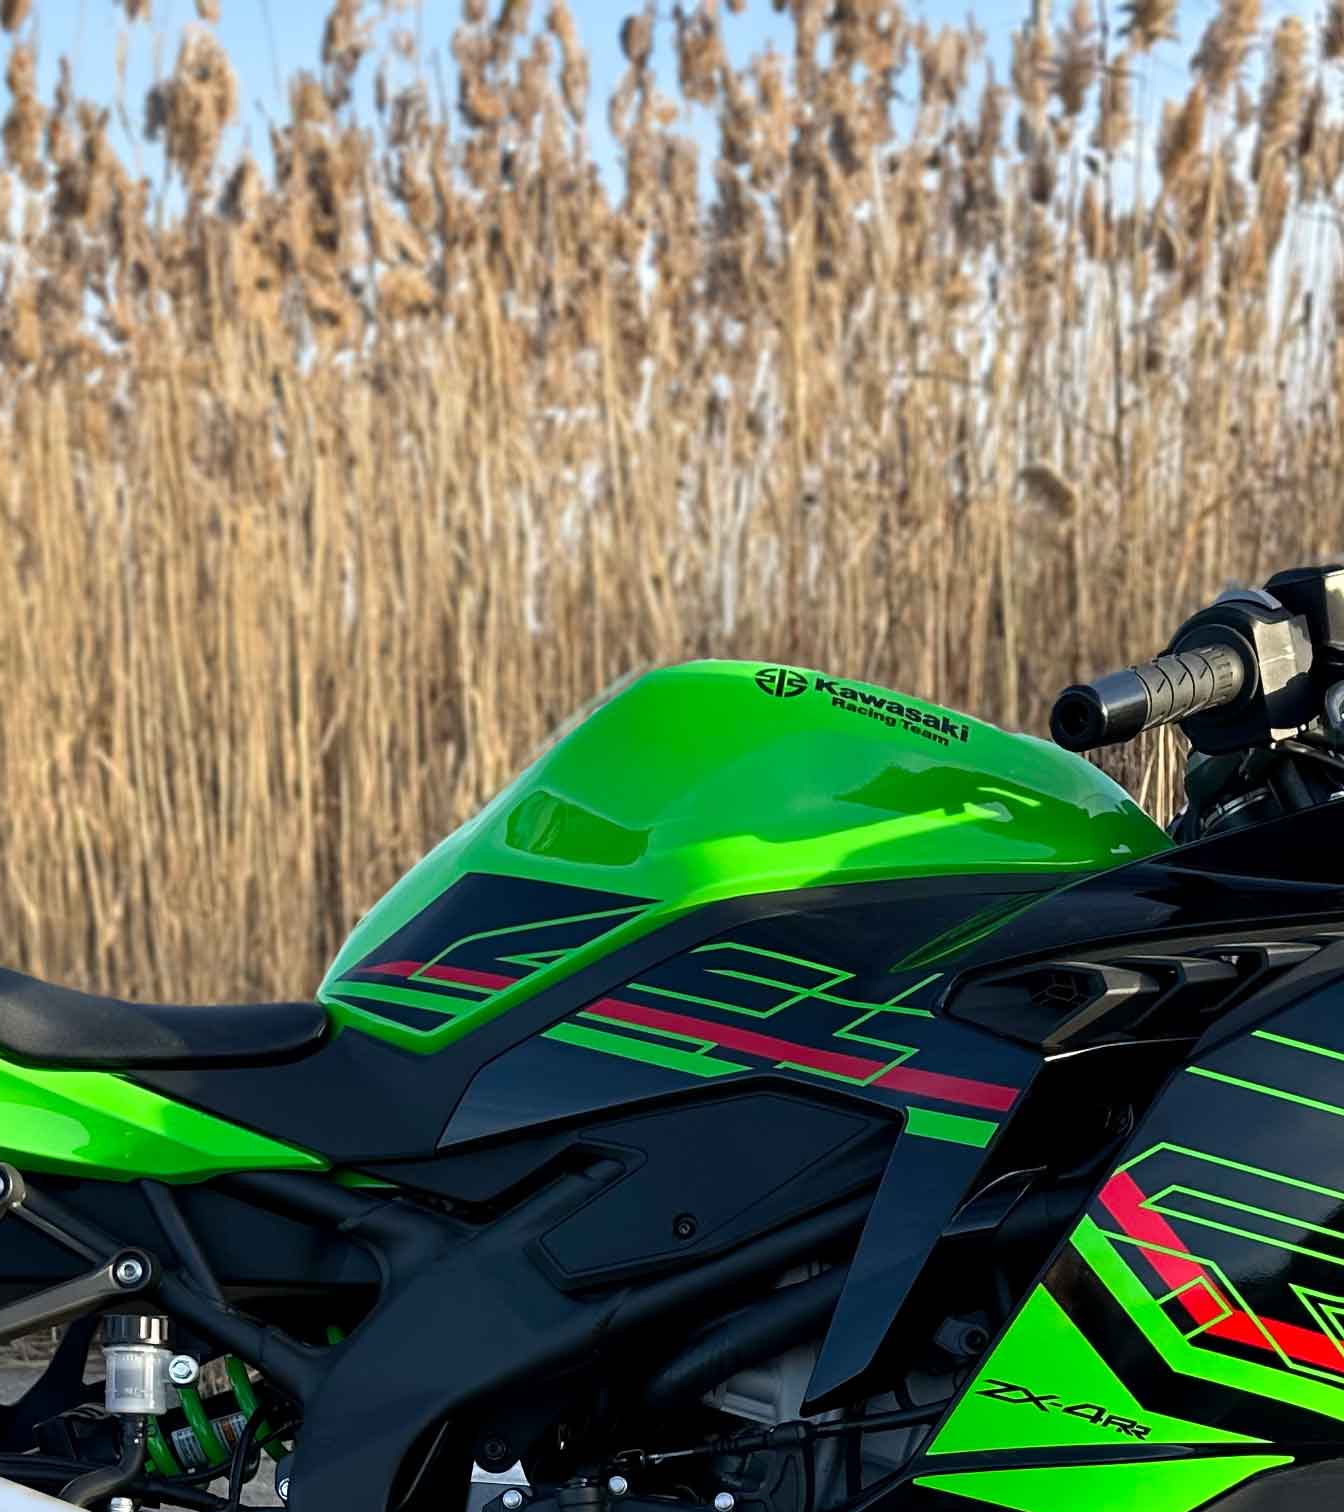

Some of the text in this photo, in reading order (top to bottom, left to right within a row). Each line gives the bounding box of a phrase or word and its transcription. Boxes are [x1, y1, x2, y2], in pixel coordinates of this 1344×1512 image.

[814, 678, 969, 742] Kawasaki
[831, 697, 948, 746] Racing Team
